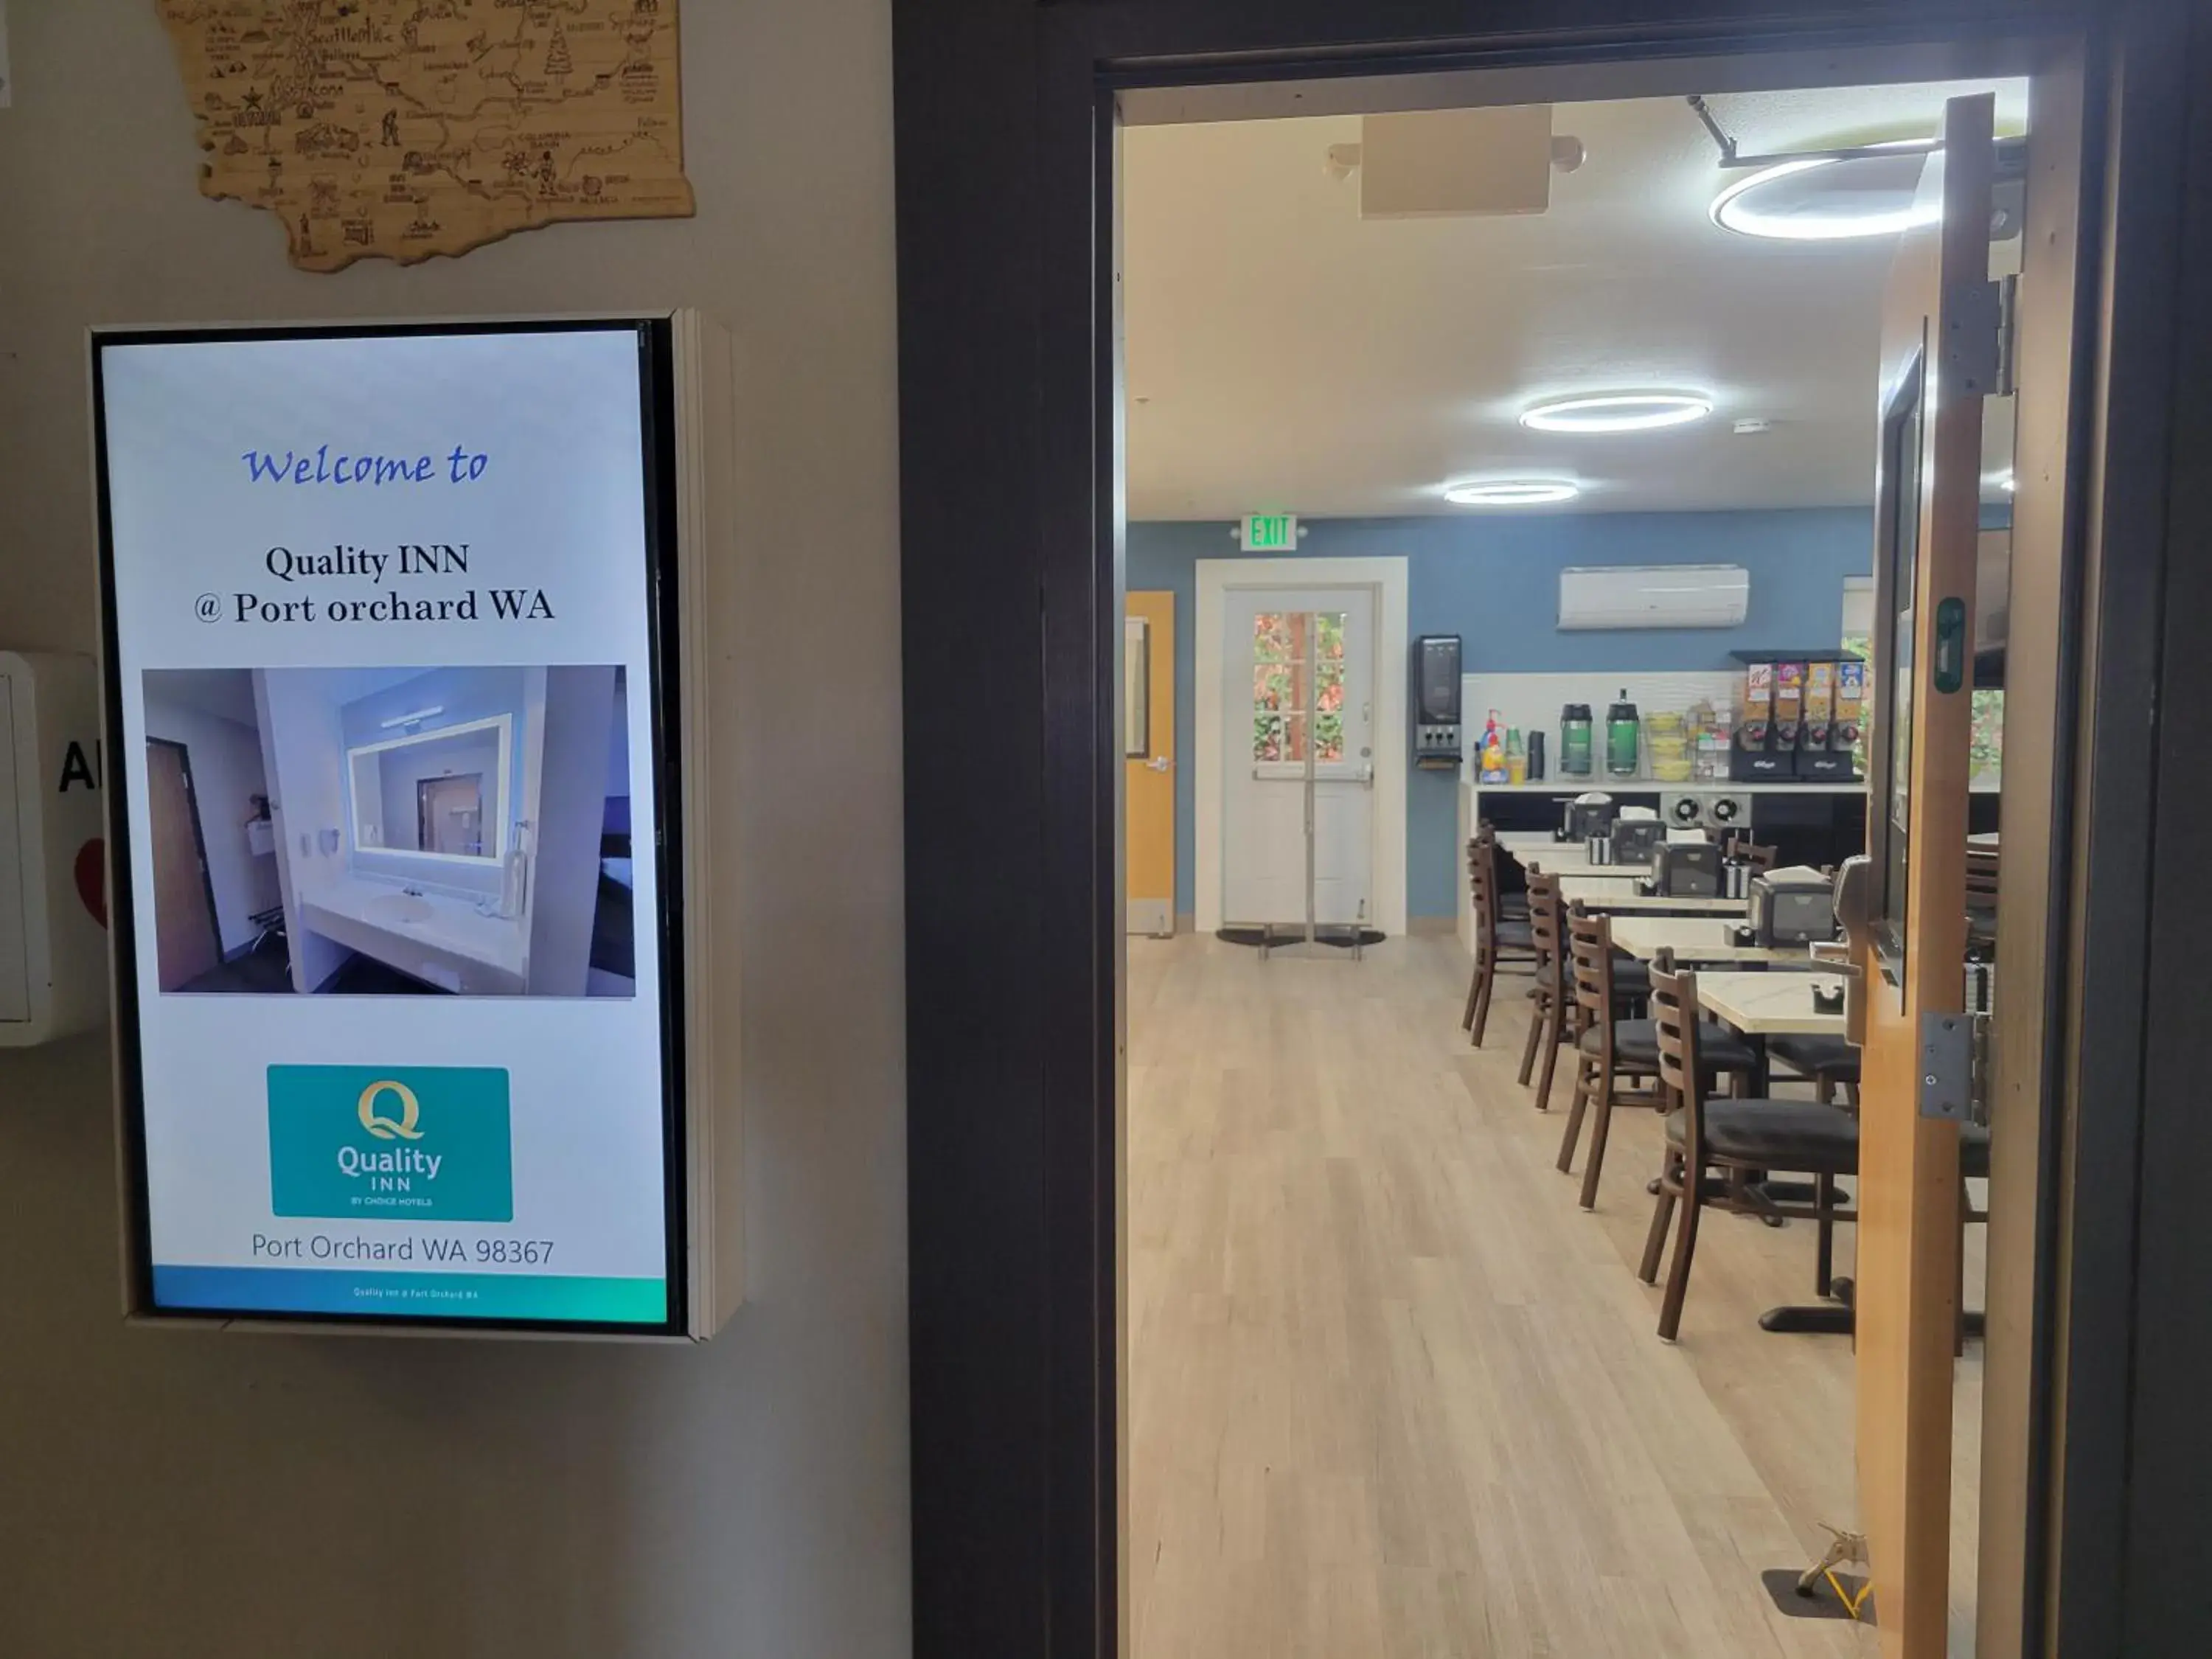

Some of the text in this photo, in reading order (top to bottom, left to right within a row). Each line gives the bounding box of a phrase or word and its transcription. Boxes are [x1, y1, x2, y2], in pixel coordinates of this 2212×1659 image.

[242, 443, 488, 486] Welcome to
[1251, 517, 1289, 546] EXIT
[265, 544, 470, 583] Quality INN
[195, 589, 555, 623] @ Port orchard WA
[59, 740, 102, 793] A
[337, 1146, 442, 1179] Quality
[371, 1178, 411, 1192] INN
[350, 1196, 433, 1208] BY CHOICE HOTELS
[252, 1234, 554, 1265] Port Orchard WA 98367
[353, 1287, 383, 1298] Quality
[411, 1288, 428, 1298] Port
[430, 1288, 463, 1299] Orchard
